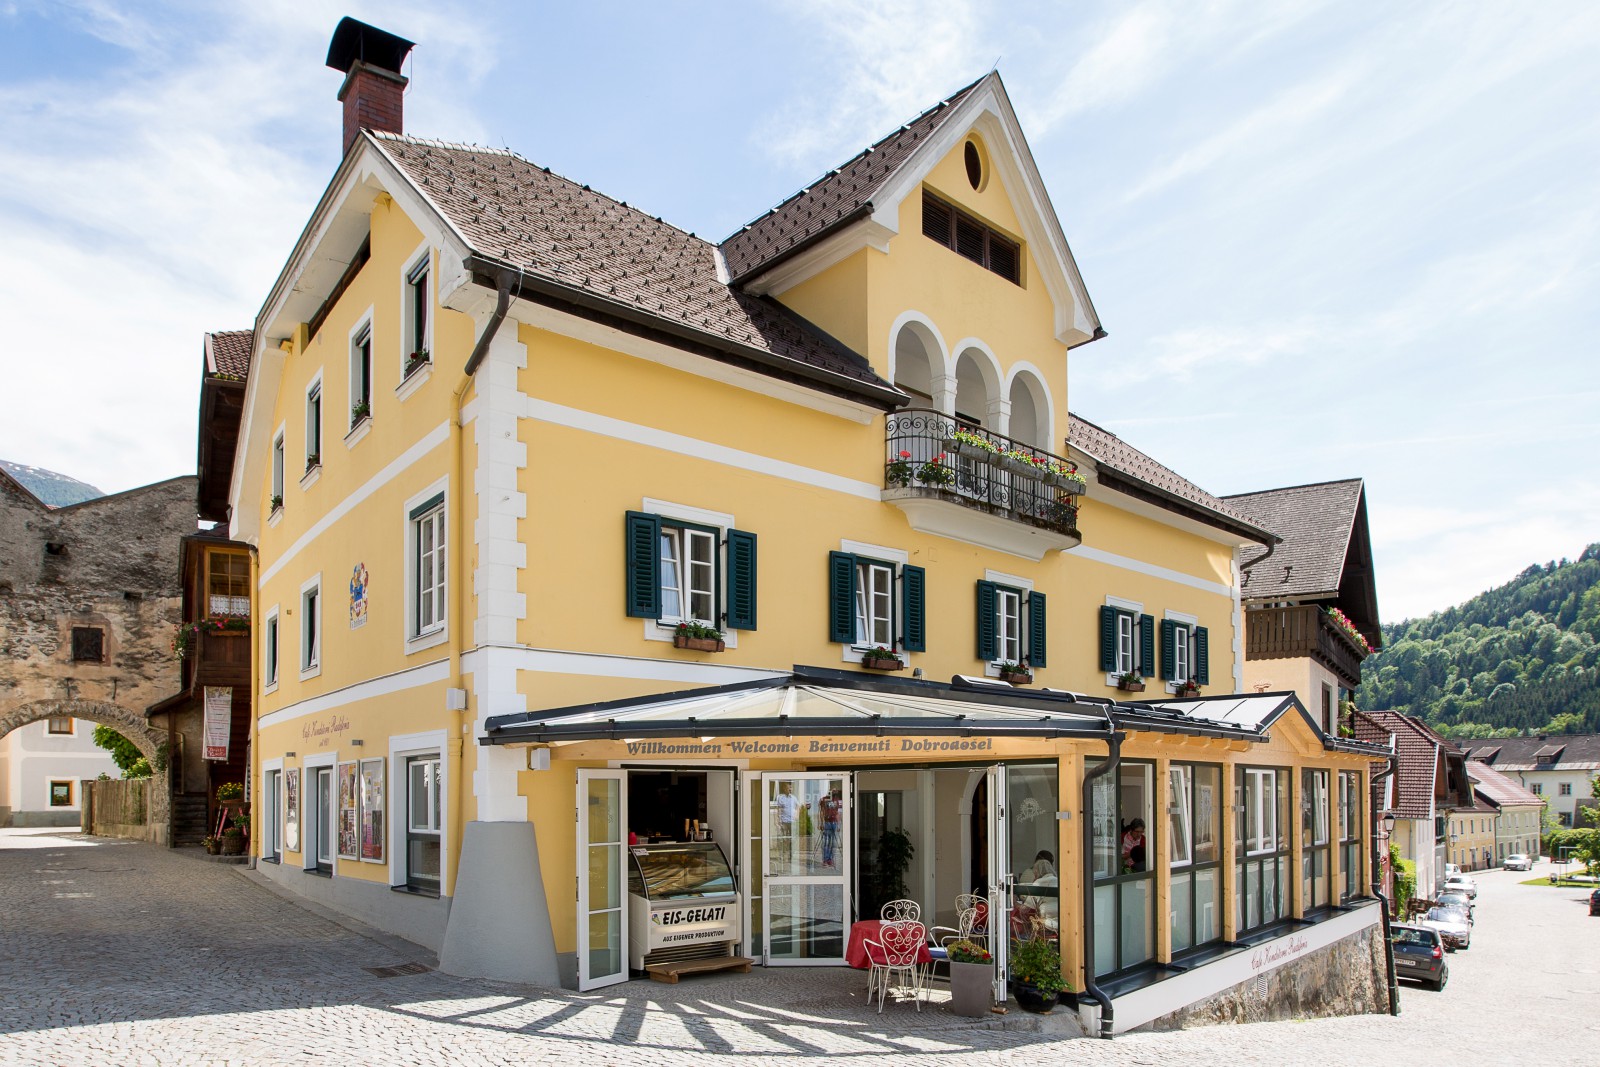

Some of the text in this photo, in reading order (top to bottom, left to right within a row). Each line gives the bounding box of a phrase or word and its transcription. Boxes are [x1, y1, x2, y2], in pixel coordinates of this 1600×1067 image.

[627, 742, 722, 755] Willkommen
[730, 740, 800, 753] Welcome
[808, 739, 891, 753] Benvenuti
[662, 906, 726, 926] EIS-GELATI
[662, 930, 725, 943] AUS EIGENER PRODUKTION
